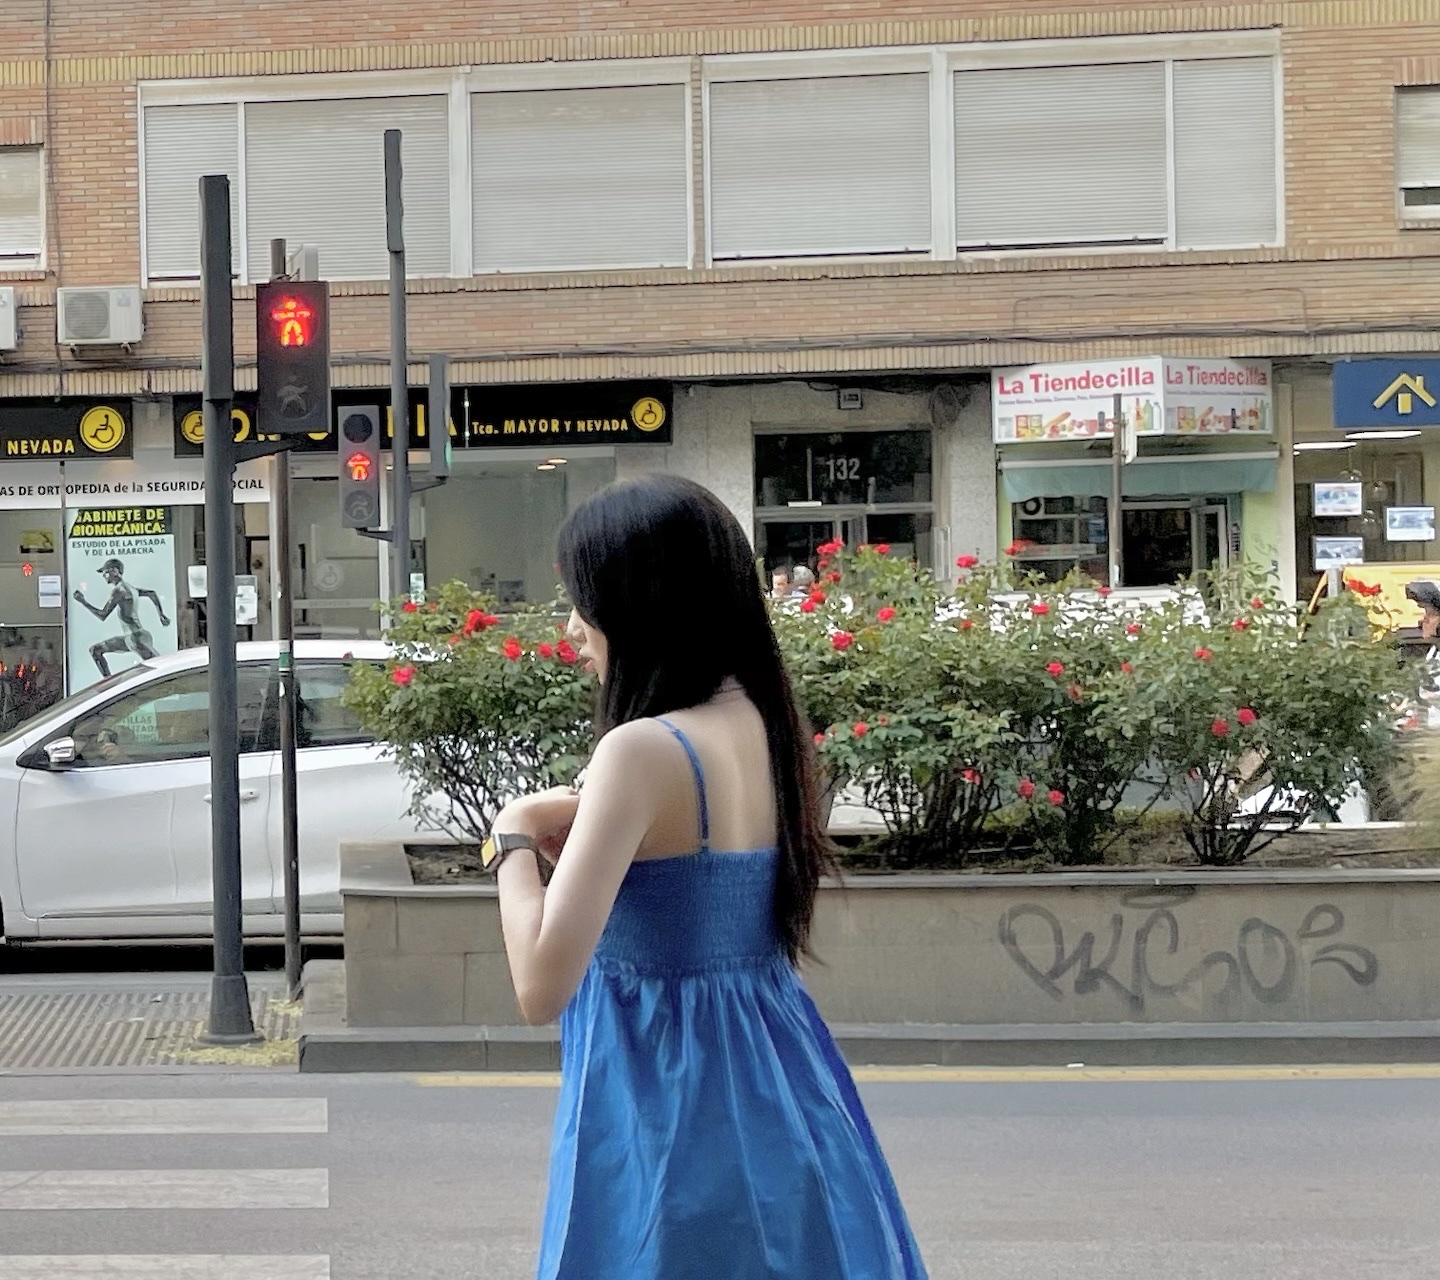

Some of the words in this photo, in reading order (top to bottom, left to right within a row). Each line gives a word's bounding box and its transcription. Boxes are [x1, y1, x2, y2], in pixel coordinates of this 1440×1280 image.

[999, 376, 1024, 395] La
[1029, 366, 1155, 393] Tiendecilla
[1166, 365, 1183, 384] La
[1187, 364, 1267, 385] Tiendecilla
[503, 419, 559, 434] MAYOR
[564, 420, 571, 433] Y
[577, 419, 628, 432] NEVADA
[7, 438, 75, 456] NEVADA
[826, 458, 860, 481] 132
[18, 486, 33, 496] DE
[114, 483, 128, 493] de
[133, 482, 143, 493] la
[146, 508, 164, 520] DE
[72, 540, 107, 549] ESTUDIO
[109, 540, 120, 548] DE
[123, 539, 133, 547] LA
[136, 538, 166, 546] PISADA
[106, 548, 115, 556] LA
[118, 547, 154, 556] MARCHA
